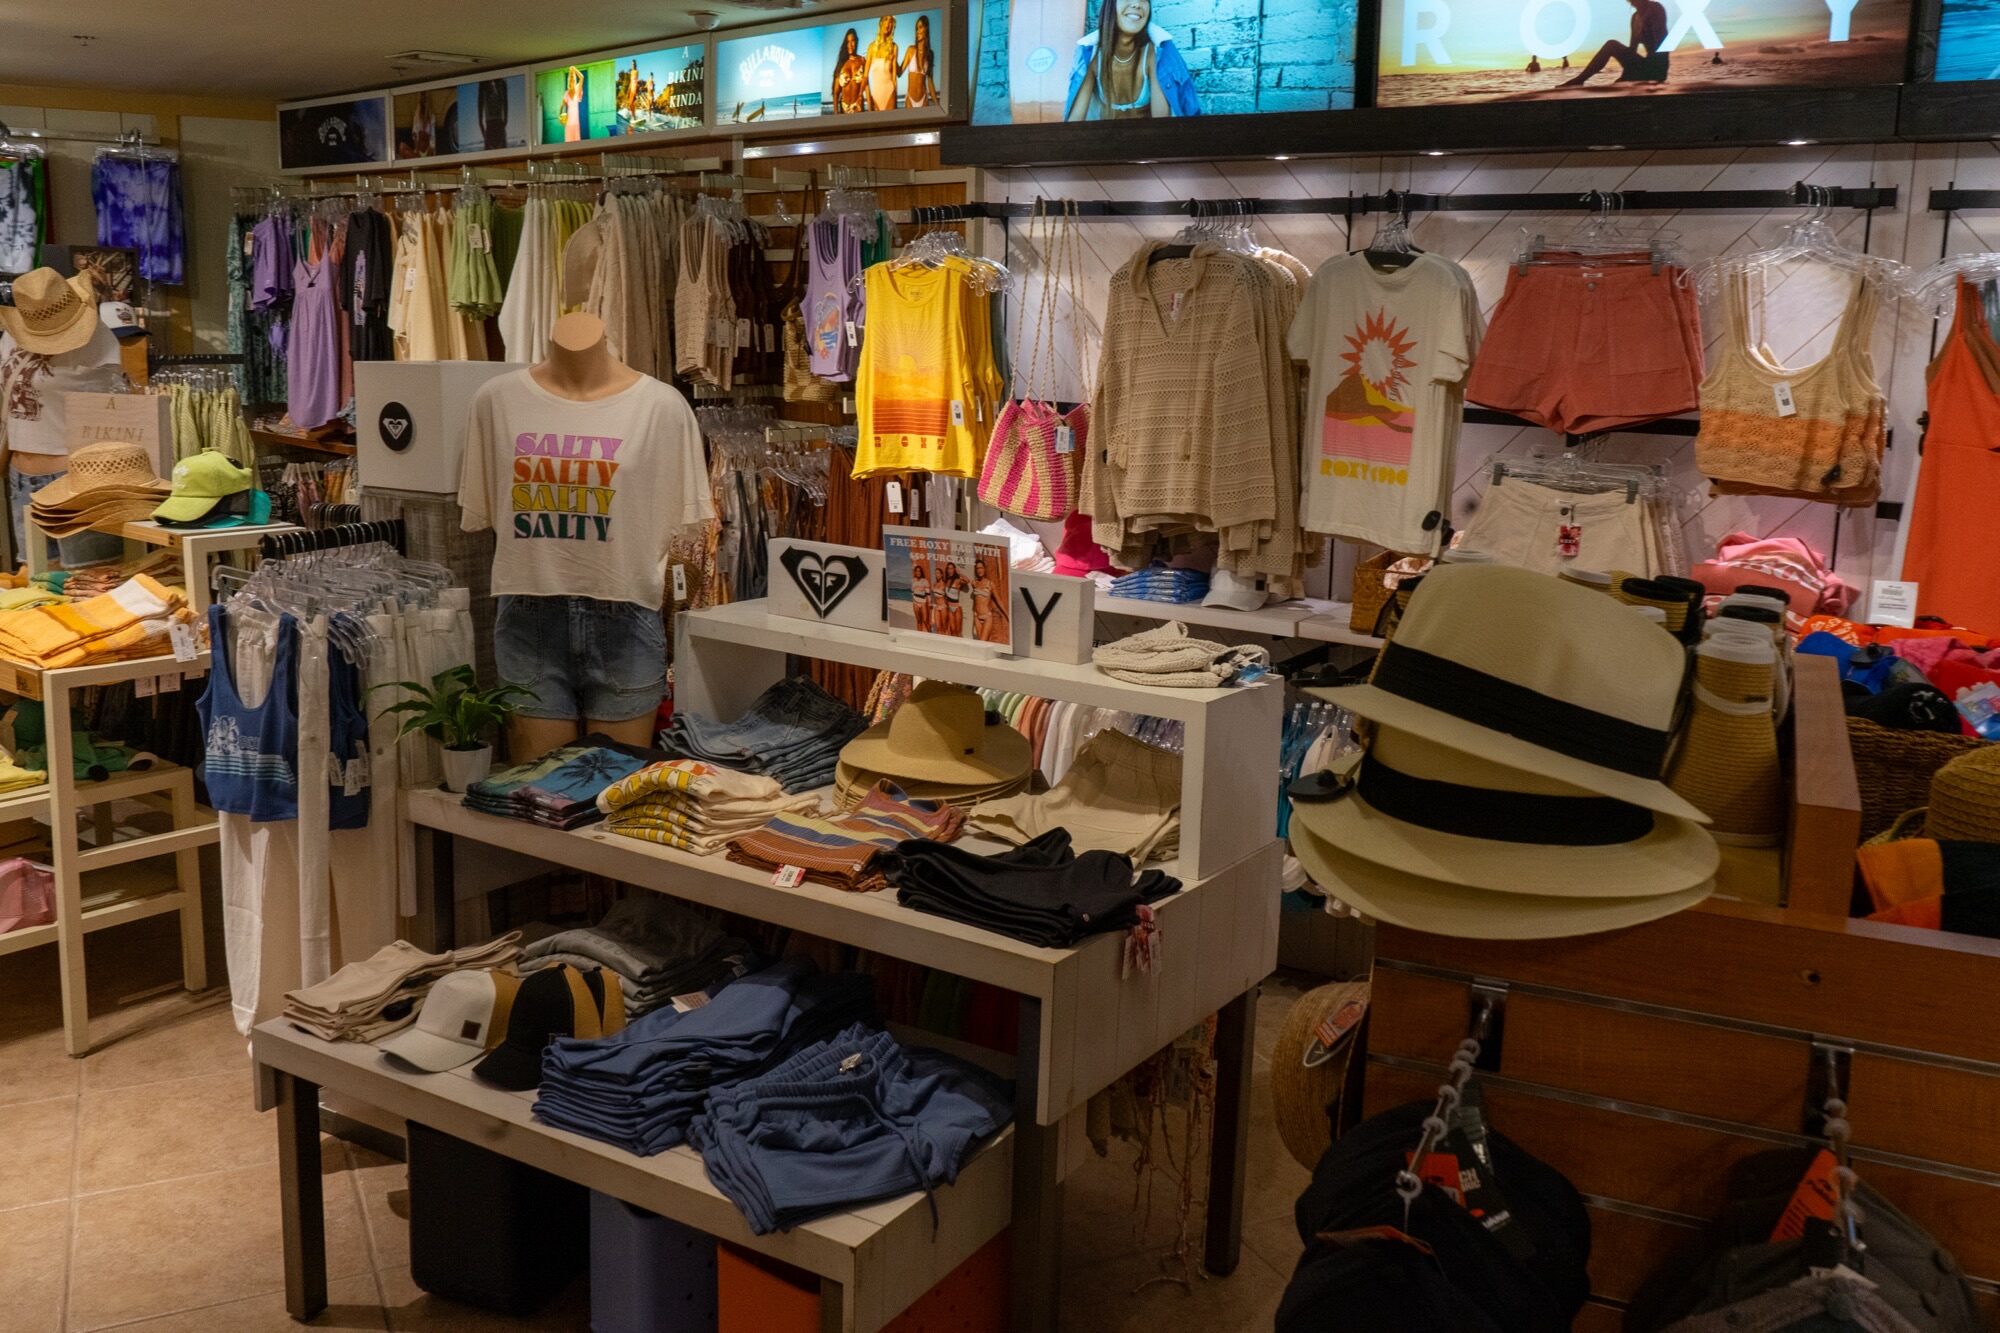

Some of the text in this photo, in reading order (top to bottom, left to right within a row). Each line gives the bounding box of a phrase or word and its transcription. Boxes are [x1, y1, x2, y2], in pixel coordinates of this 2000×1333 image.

[1400, 0, 1859, 66] ROXY
[682, 46, 688, 58] A
[668, 67, 704, 84] BIKINI
[669, 92, 703, 108] KINDA
[105, 397, 116, 410] A
[82, 425, 145, 441] BIKINI
[514, 432, 623, 460] SALTY
[513, 456, 620, 487] SALTY
[512, 484, 616, 515] SALTY
[514, 512, 612, 542] SALTY
[889, 537, 918, 548] FREE
[919, 540, 949, 551] ROXY
[974, 544, 1001, 557] WITH
